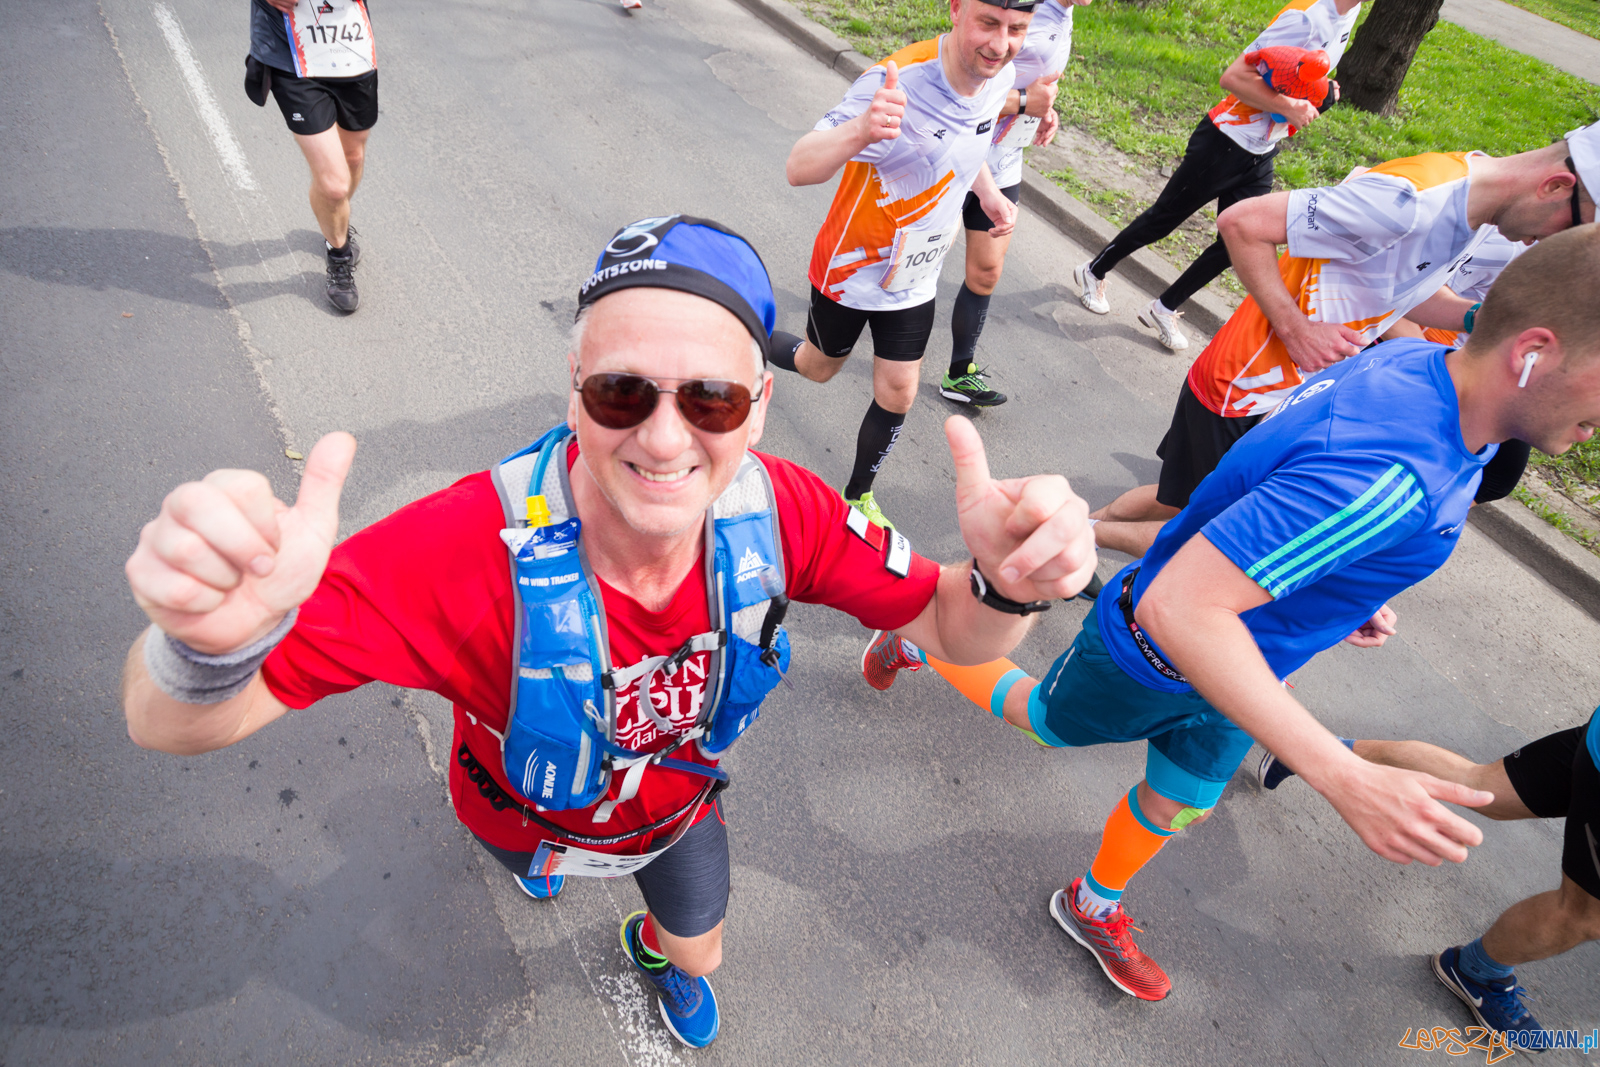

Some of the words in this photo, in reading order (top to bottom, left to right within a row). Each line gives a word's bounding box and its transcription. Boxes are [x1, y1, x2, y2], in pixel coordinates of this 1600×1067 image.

[306, 22, 364, 44] 11742
[581, 258, 668, 295] SPORTSZONE
[519, 576, 530, 584] AIR
[530, 577, 549, 587] WIND
[550, 572, 579, 586] TRACKER
